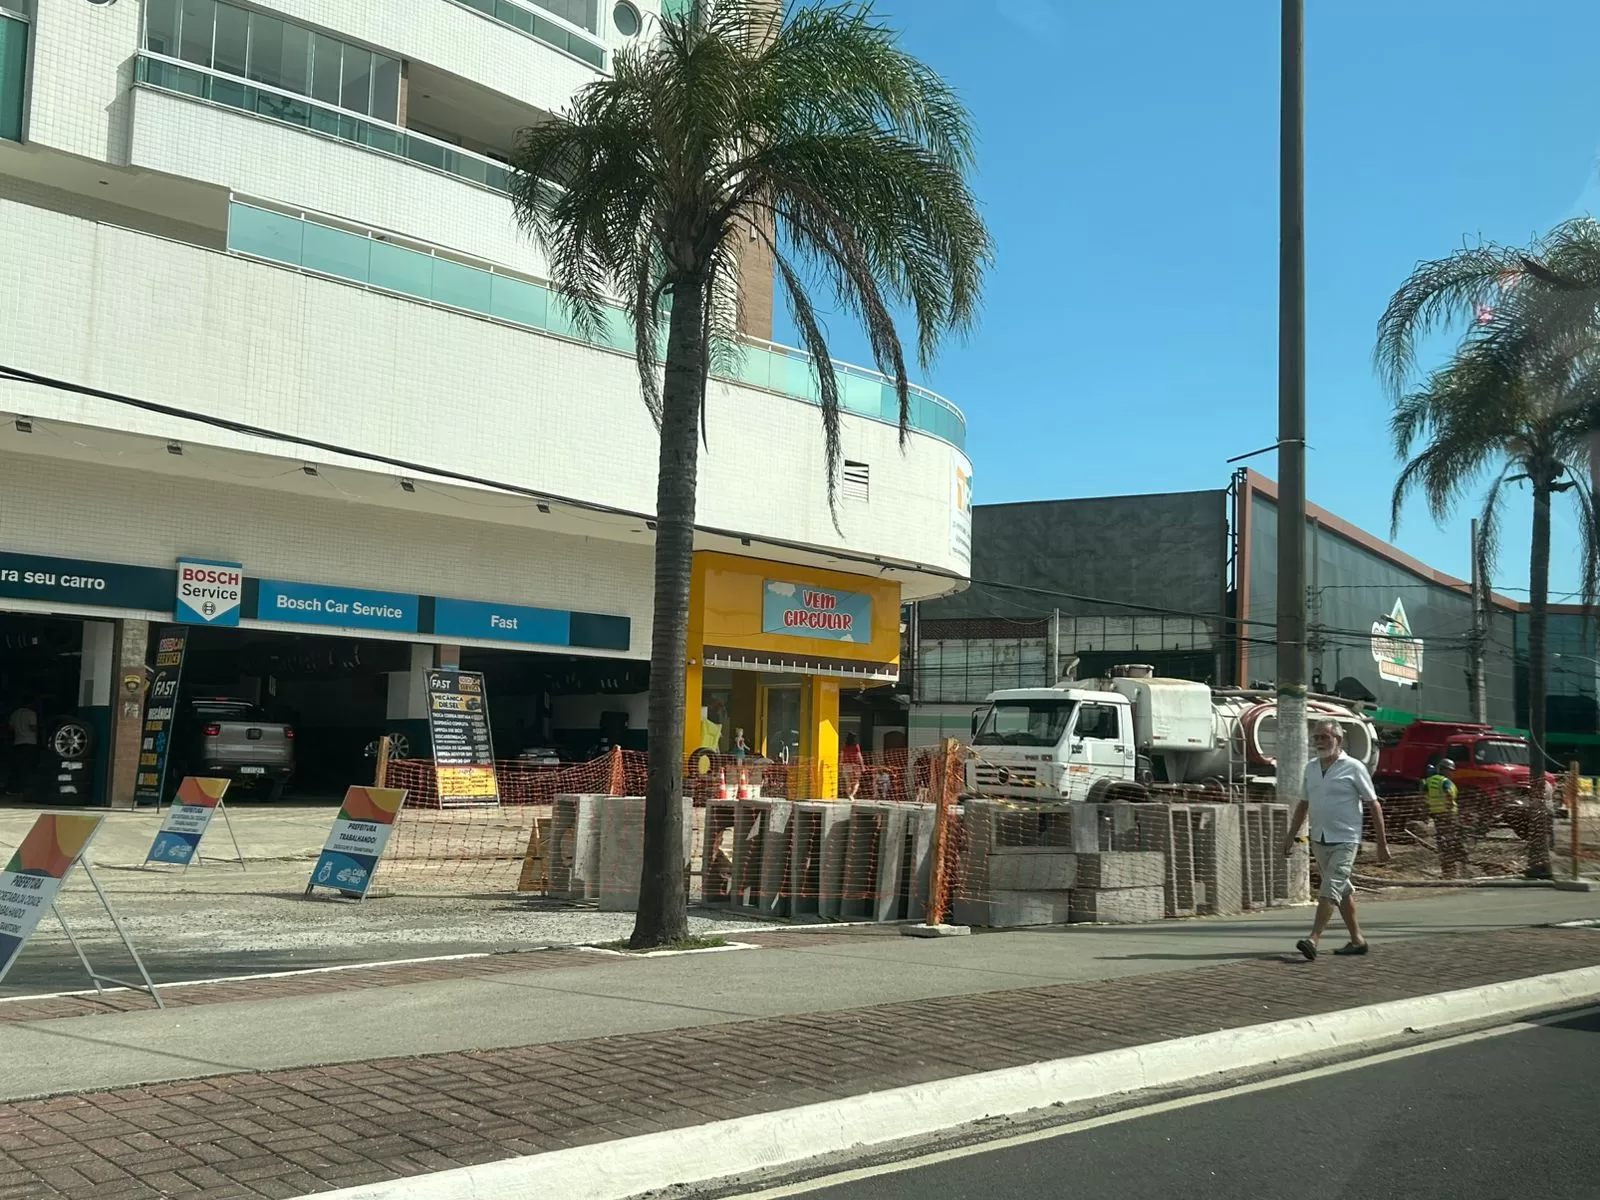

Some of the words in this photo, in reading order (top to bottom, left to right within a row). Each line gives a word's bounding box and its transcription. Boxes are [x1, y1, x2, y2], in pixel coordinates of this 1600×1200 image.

[24, 571, 56, 585] seu
[60, 574, 106, 590] carro
[182, 568, 239, 586] BOSCH
[182, 583, 238, 600] Service
[803, 590, 836, 610] VEM
[276, 595, 321, 611] Bosch
[325, 599, 349, 614] Car
[352, 601, 403, 619] Service
[491, 615, 518, 630] Fast
[784, 609, 853, 631] CIRCULAR
[154, 681, 176, 696] FAST
[432, 679, 451, 689] FAST
[347, 822, 377, 832] PREFEITURA
[10, 875, 45, 890] PREFEITURA
